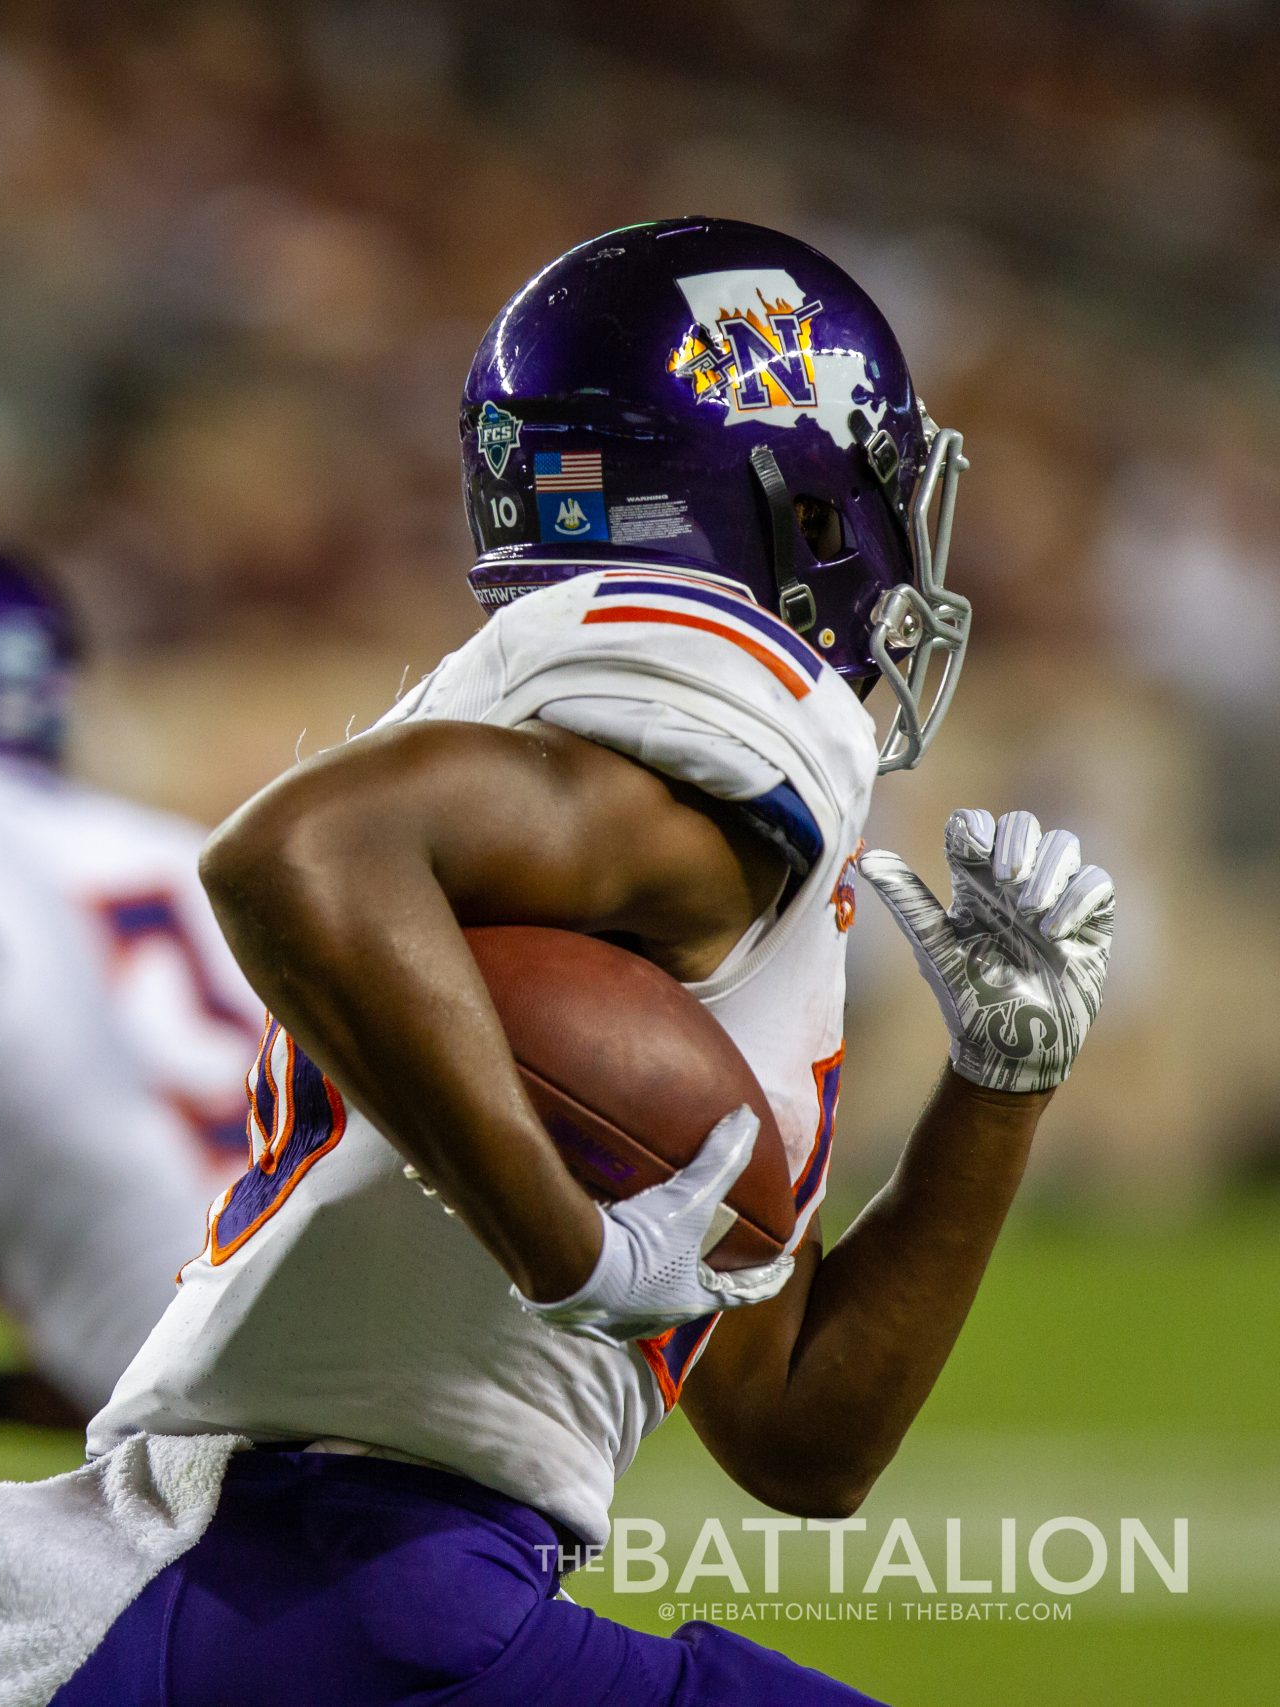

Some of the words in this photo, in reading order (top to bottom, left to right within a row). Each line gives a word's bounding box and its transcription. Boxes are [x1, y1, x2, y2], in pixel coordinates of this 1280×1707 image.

[483, 425, 512, 443] FCS
[626, 494, 669, 503] WARNING
[490, 496, 518, 528] 10
[476, 585, 545, 604] RTHWEST
